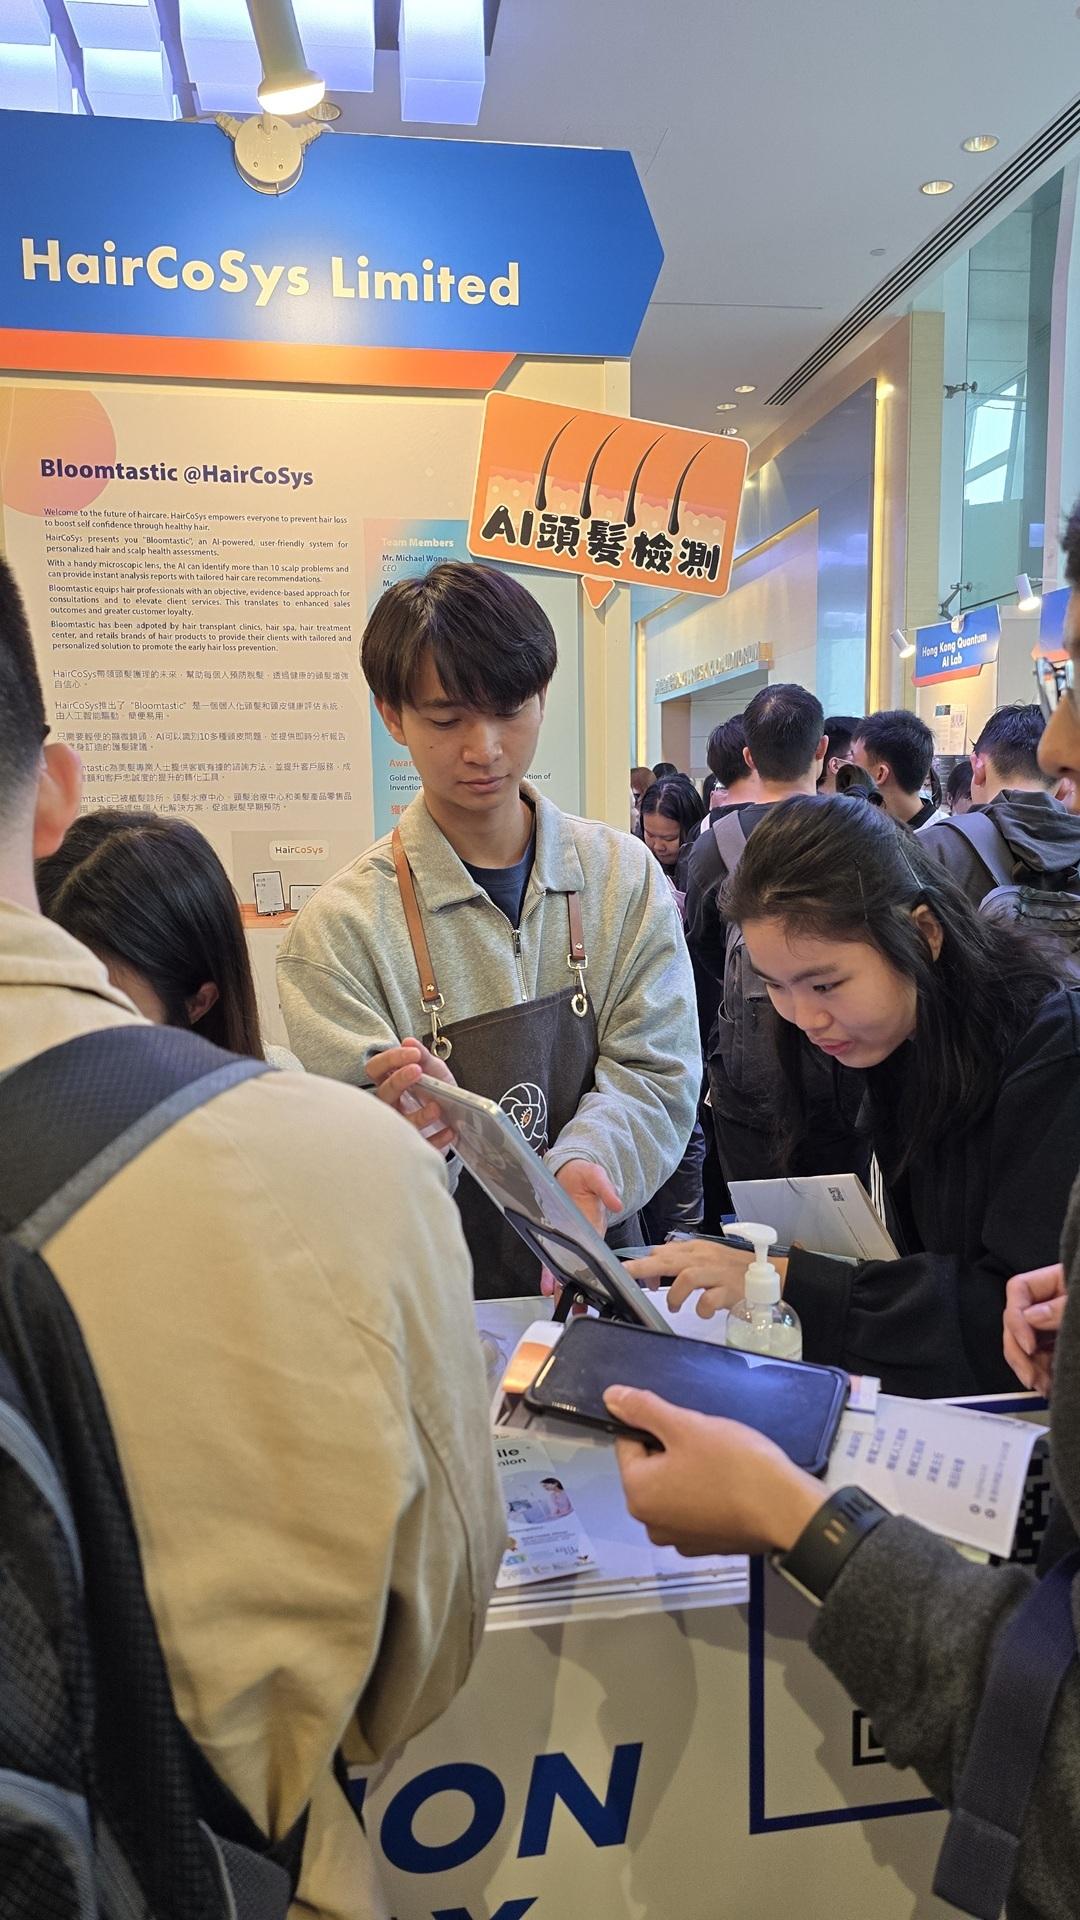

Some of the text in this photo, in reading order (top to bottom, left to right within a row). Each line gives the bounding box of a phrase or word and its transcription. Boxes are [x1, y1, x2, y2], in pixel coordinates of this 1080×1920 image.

[22, 238, 520, 307] HairCoSys Limited
[40, 458, 314, 490] Bloomtastic @HairCoSys
[44, 508, 78, 516] Welcome
[89, 509, 102, 517] the
[103, 510, 126, 518] future
[127, 510, 135, 518] of
[170, 512, 206, 522] HairCoSys
[208, 514, 245, 523] empowers
[246, 515, 279, 524] everyone
[289, 515, 316, 525] prevent
[333, 516, 346, 524] loss
[54, 519, 75, 527] boost
[92, 520, 132, 528] confidence
[133, 521, 163, 531] through
[164, 522, 192, 532] healthy
[45, 533, 83, 544] HairCoSys
[87, 534, 119, 544] presents
[124, 537, 138, 545] you
[260, 539, 304, 549] user-friendly
[309, 540, 333, 550] system
[338, 540, 347, 548] for
[382, 538, 454, 548] Team Members
[481, 505, 721, 581] AI頭髮檢測
[46, 544, 94, 555] personalized
[112, 546, 125, 554] and
[127, 546, 146, 556] scalp
[147, 547, 171, 555] health
[382, 554, 394, 562] Mr.
[395, 554, 425, 562] Michael
[47, 559, 65, 567] With
[73, 560, 97, 569] handy
[99, 560, 143, 570] microscopic
[201, 562, 229, 572] identify
[271, 564, 279, 572] 10
[281, 564, 299, 574] scalp
[300, 564, 333, 574] problems
[336, 565, 348, 573] and
[382, 564, 397, 572] CEO
[62, 570, 91, 580] provide
[92, 571, 118, 579] instant
[120, 571, 149, 581] analysis
[150, 572, 177, 582] reports
[178, 572, 194, 580] with
[196, 573, 224, 581] tailored
[225, 573, 238, 581] hair
[48, 584, 93, 592] Bloomtastic
[94, 585, 119, 595] equips
[120, 586, 134, 594] hair
[136, 586, 184, 596] professionals
[185, 587, 202, 595] with
[249, 588, 304, 597] evidence-based
[306, 589, 338, 599] approach
[49, 595, 99, 603] consultations
[104, 596, 118, 604] and
[123, 596, 130, 604] to
[166, 597, 187, 605] client
[226, 598, 239, 606] This
[244, 598, 278, 606] translates
[295, 599, 329, 607] enhanced
[333, 599, 350, 607] sales
[50, 606, 86, 614] outcomes
[88, 606, 102, 614] and
[104, 607, 129, 616] greater
[132, 607, 165, 615] customer
[51, 620, 95, 628] Bloomtastic
[114, 621, 132, 629] been
[170, 622, 179, 631] by
[182, 622, 196, 630] hair
[199, 622, 235, 632] transplant
[265, 623, 279, 631] hair
[316, 624, 350, 632] treatment
[79, 631, 93, 639] and
[96, 631, 118, 639] retails
[120, 632, 146, 640] brands
[148, 632, 155, 640] of
[157, 632, 172, 640] hair
[174, 632, 206, 642] products
[218, 633, 245, 642] provide
[247, 633, 264, 641] their
[266, 633, 289, 641] clients
[309, 634, 336, 642] tailored
[338, 634, 351, 642] and
[52, 641, 99, 651] personalized
[101, 642, 131, 650] solution
[132, 642, 140, 650] to
[141, 642, 173, 652] promote
[188, 643, 205, 652] early
[207, 643, 221, 651] hair
[222, 643, 236, 651] loss
[922, 633, 988, 657] Hong Kong Quantum
[942, 652, 963, 667] AI Lab
[543, 772, 551, 780] of
[275, 845, 324, 856] HairCoSys
